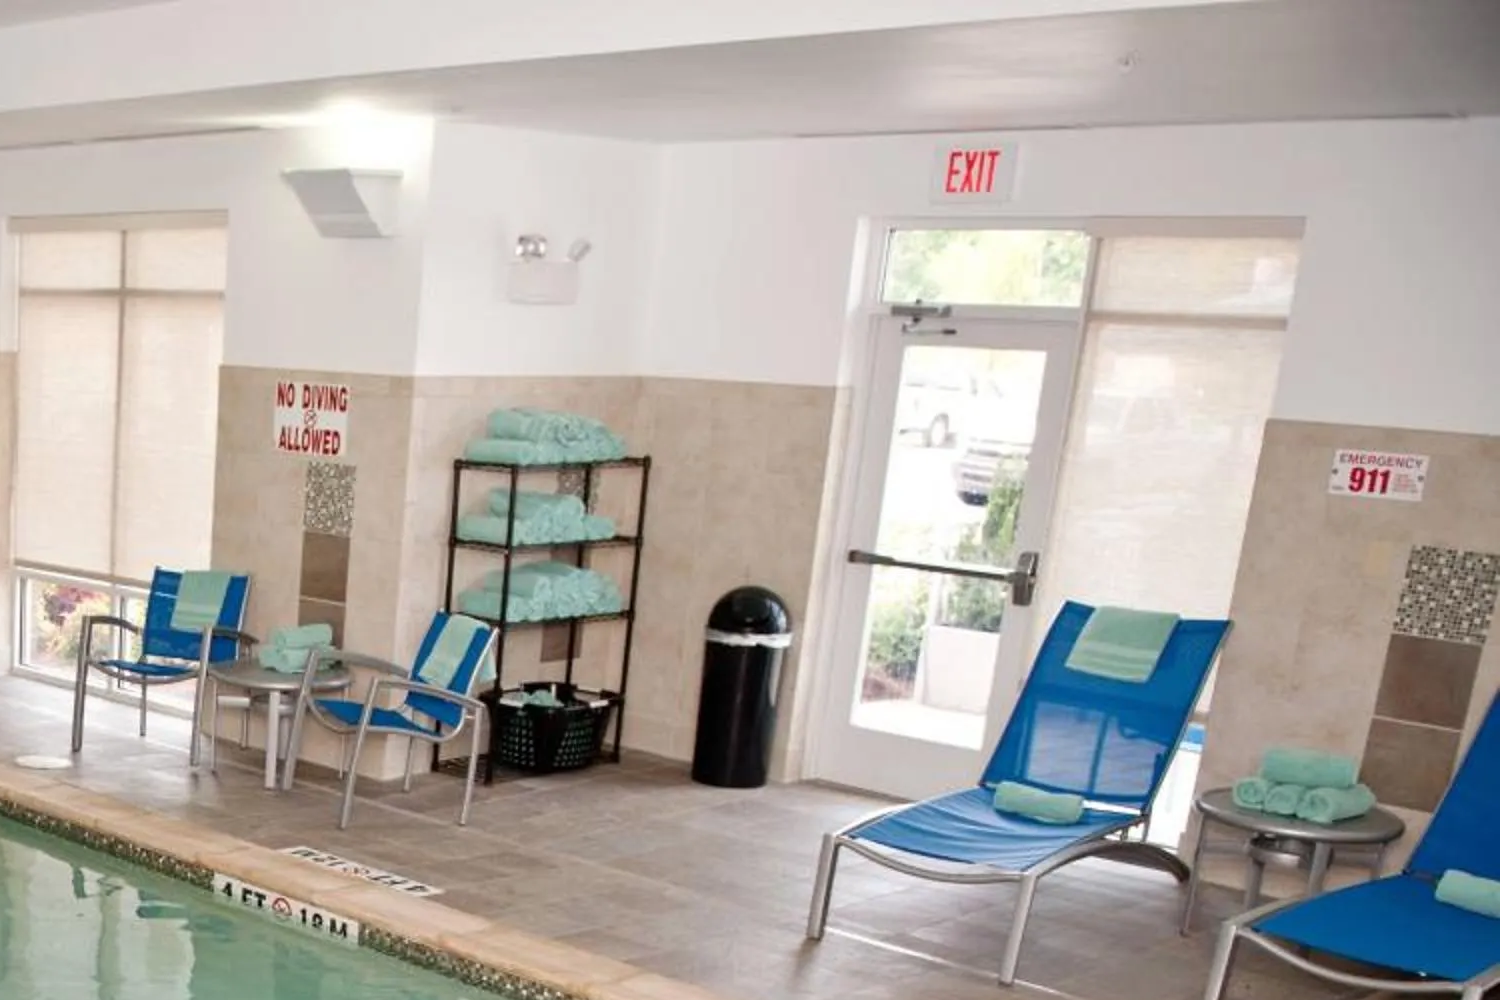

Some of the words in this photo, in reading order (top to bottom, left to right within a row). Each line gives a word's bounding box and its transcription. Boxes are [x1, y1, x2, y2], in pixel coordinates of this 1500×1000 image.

[946, 150, 1001, 192] EXIT
[277, 382, 295, 408] NO
[302, 384, 347, 412] DIVING
[278, 426, 341, 455] ALLOWED
[1339, 453, 1423, 469] EMERGENCY
[1349, 467, 1390, 494] 911
